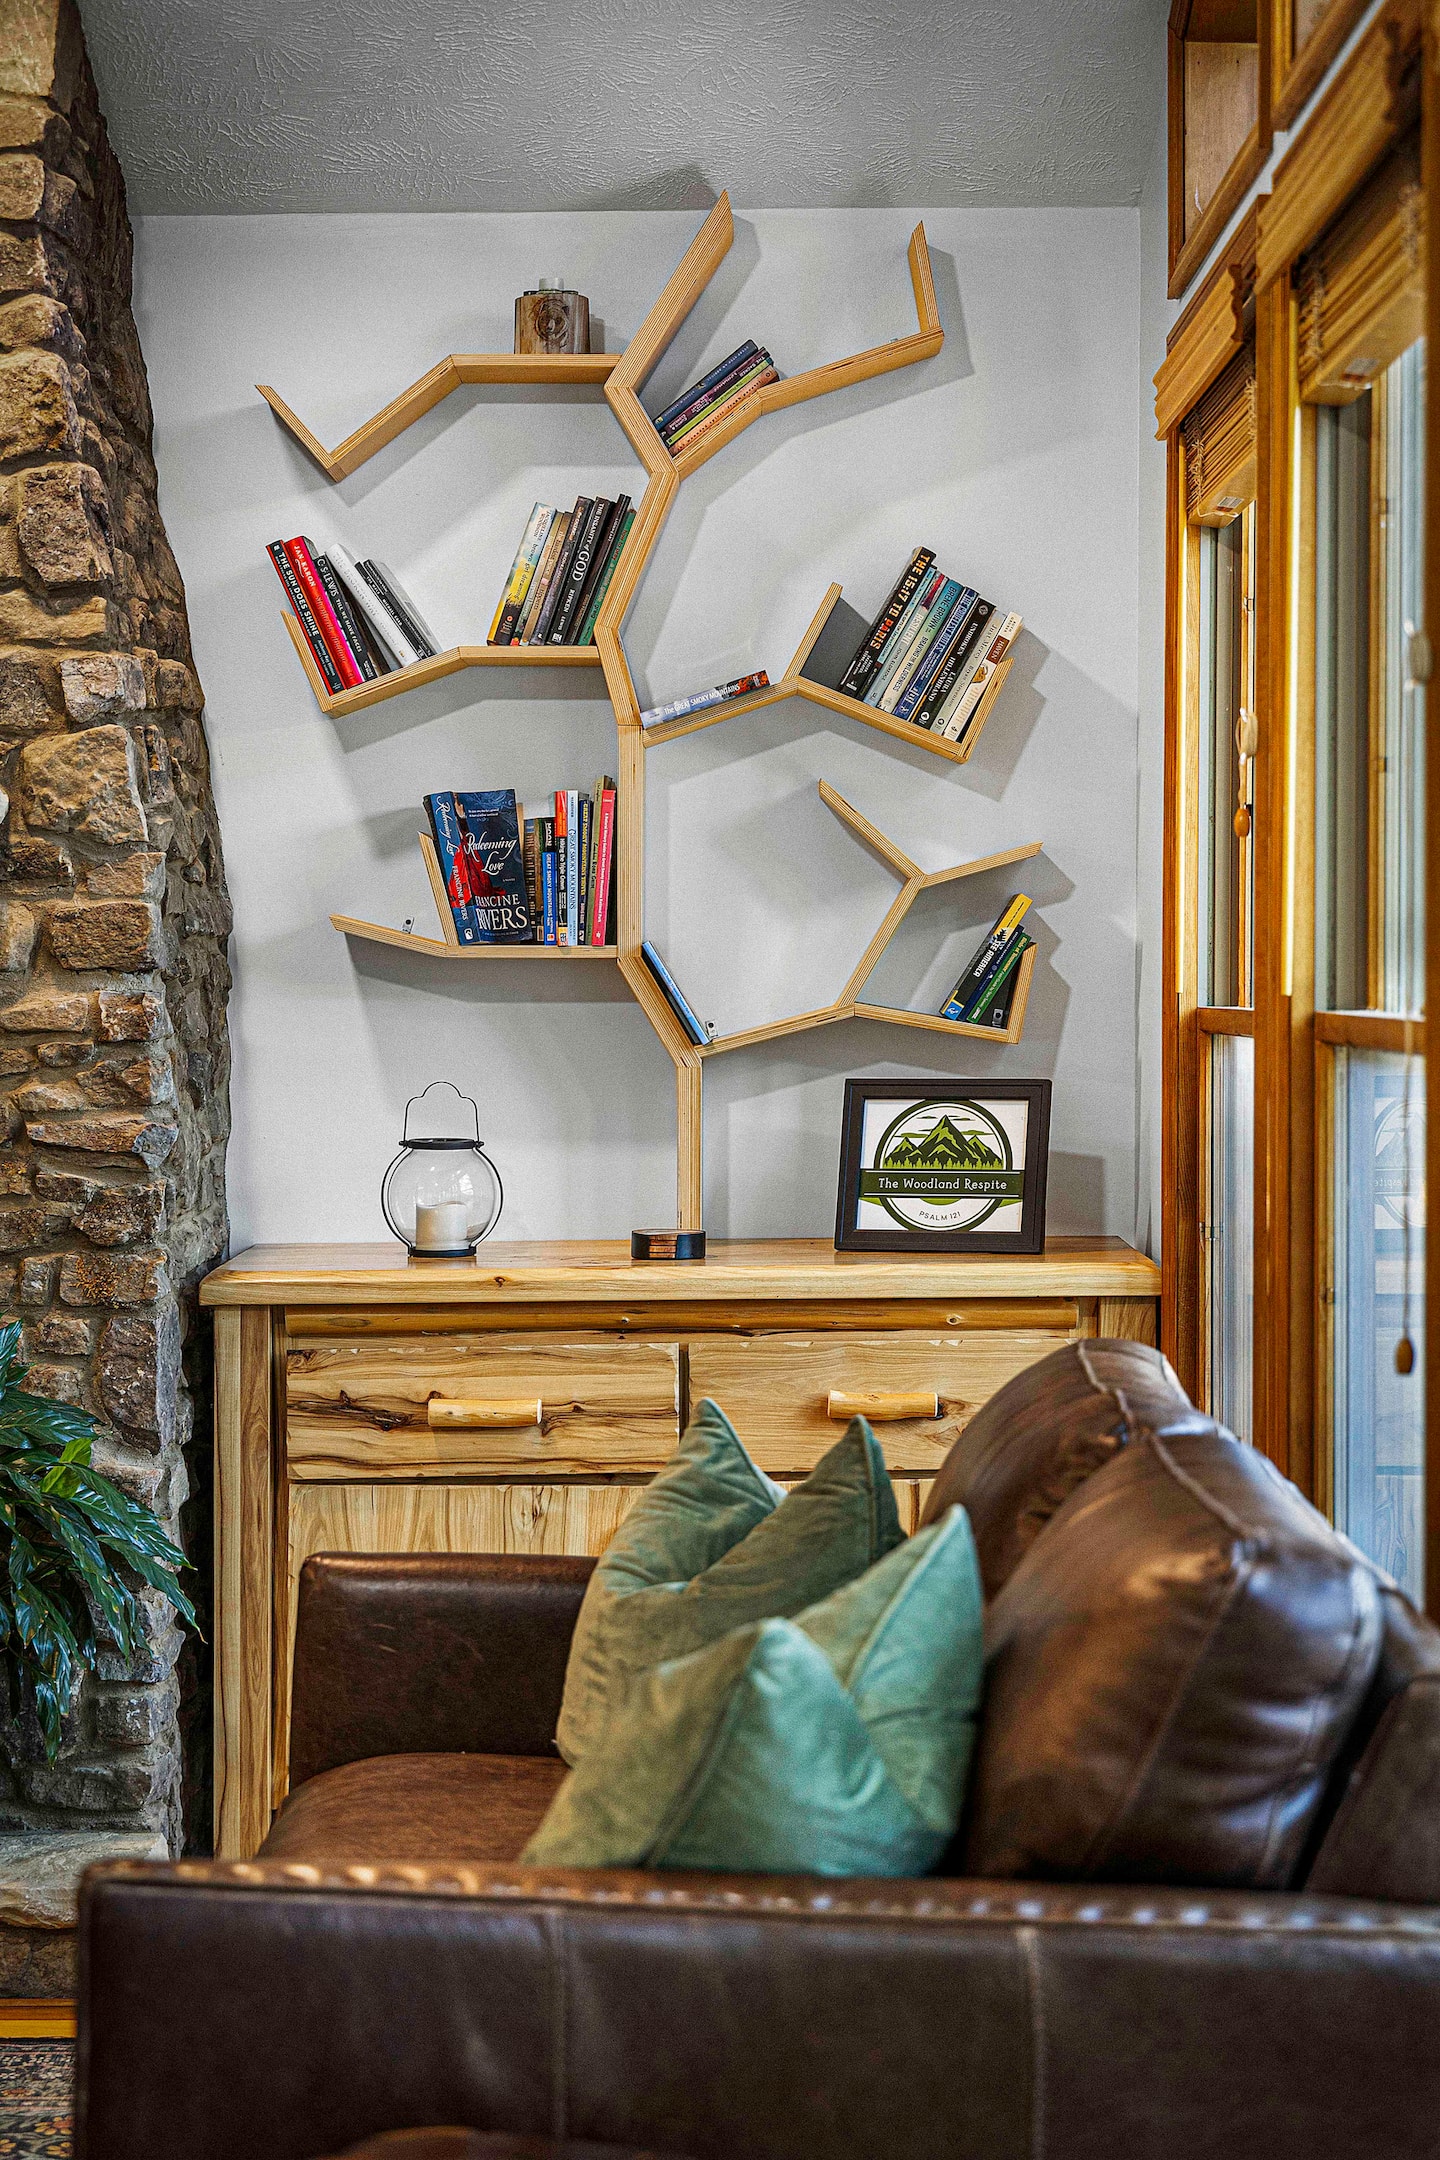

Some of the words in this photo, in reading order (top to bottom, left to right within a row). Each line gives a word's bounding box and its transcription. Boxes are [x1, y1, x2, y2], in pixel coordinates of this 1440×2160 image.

[595, 502, 604, 514] THE
[586, 514, 600, 544] INSANITY
[527, 542, 538, 562] brown
[911, 552, 930, 576] THE
[293, 544, 304, 559] JAN
[300, 560, 316, 587] KARON
[522, 562, 531, 573] girl
[570, 549, 591, 582] GOD
[277, 551, 290, 570] THE
[284, 569, 297, 587] SUN
[292, 586, 308, 610] DOES
[302, 610, 319, 636] SHINE
[513, 573, 527, 600] dreaming
[896, 574, 918, 602] 15:17
[562, 588, 575, 613] RIPKEN
[887, 601, 903, 618] TO
[334, 598, 344, 612] TILL
[340, 611, 347, 619] WE
[344, 619, 355, 635] HAVE
[350, 635, 362, 653] FACES
[900, 611, 924, 646] RESILIENT
[927, 605, 945, 630] BROWN
[869, 616, 894, 650] PARIS
[956, 621, 978, 657] UNBROKEN
[985, 623, 997, 639] Just
[892, 646, 902, 660] JOHN
[911, 635, 928, 658] BRAVING
[973, 638, 989, 660] Mercy
[990, 639, 1005, 660] HAVEN
[892, 660, 914, 692] WILDERNESS
[926, 655, 956, 702] HILLENBRAND
[940, 670, 956, 694] LAURA
[663, 705, 675, 715] The
[673, 700, 690, 711] GREAT
[689, 693, 709, 706] SMOKY
[708, 681, 740, 699] MOUNTAINS
[436, 796, 452, 839] Redeeming
[446, 841, 460, 856] Love
[464, 832, 517, 862] Redeeming
[482, 851, 504, 875] Love
[450, 864, 464, 898] FRANCINE
[457, 898, 469, 920] RIVERS
[476, 906, 528, 930] RIVERS
[989, 938, 1002, 952] SEE
[1017, 936, 1027, 948] Birds
[972, 948, 994, 978] AMERICA
[879, 1177, 899, 1189] The
[903, 1177, 960, 1189] Woodland
[964, 1178, 1008, 1191] Respite
[919, 1210, 948, 1221] PSALM
[950, 1211, 961, 1219] 121
